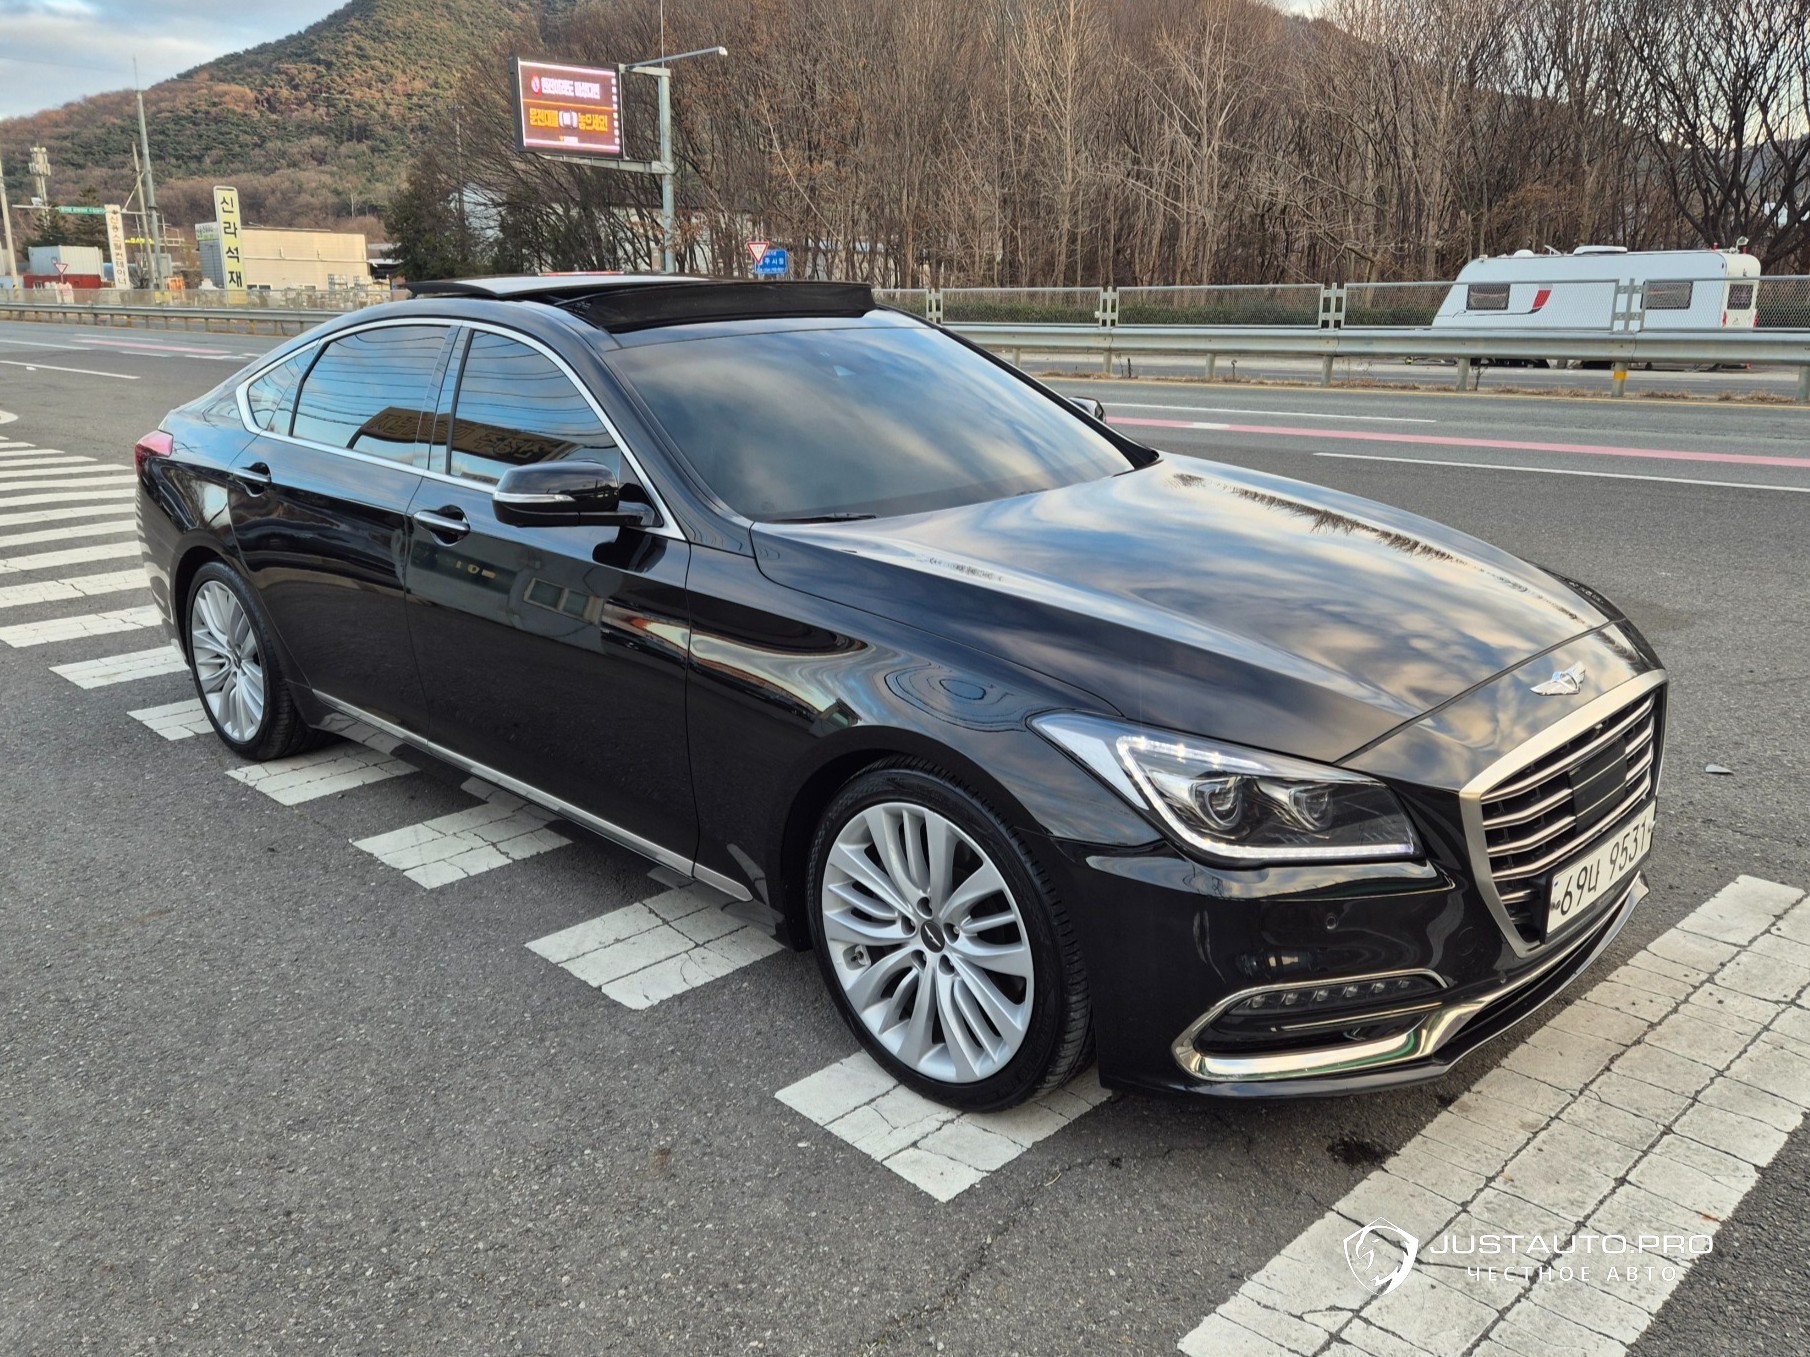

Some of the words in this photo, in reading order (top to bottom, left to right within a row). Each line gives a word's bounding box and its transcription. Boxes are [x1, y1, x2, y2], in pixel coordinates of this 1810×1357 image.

[529, 107, 559, 127] 운전대를
[220, 195, 243, 289] 신라석재
[1609, 815, 1647, 880] 9531
